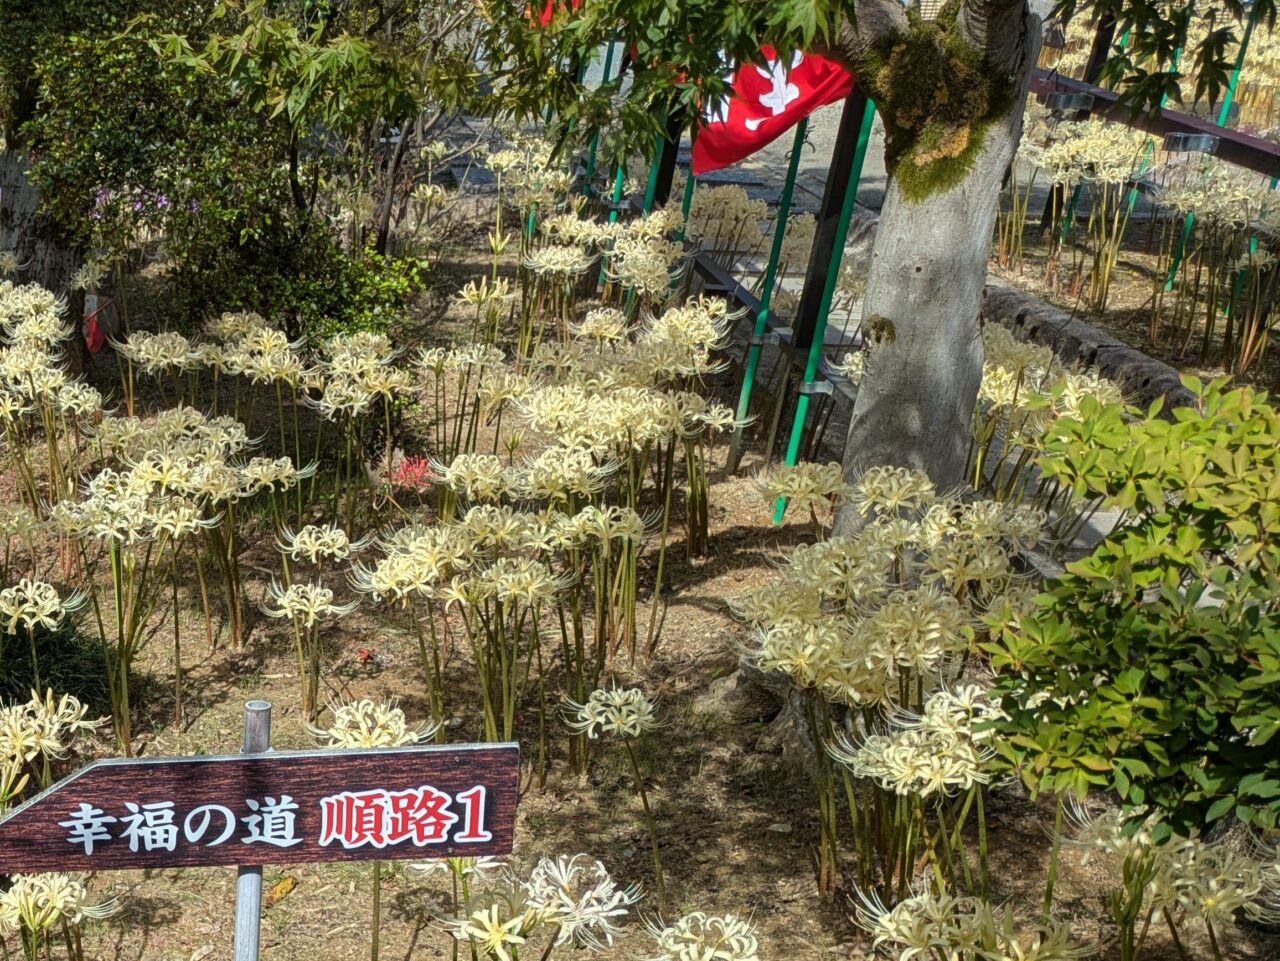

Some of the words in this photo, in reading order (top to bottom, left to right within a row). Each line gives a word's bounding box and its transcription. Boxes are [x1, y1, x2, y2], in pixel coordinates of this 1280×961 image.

[58, 796, 303, 855] 幸福の道
[319, 785, 492, 848] 順路1
